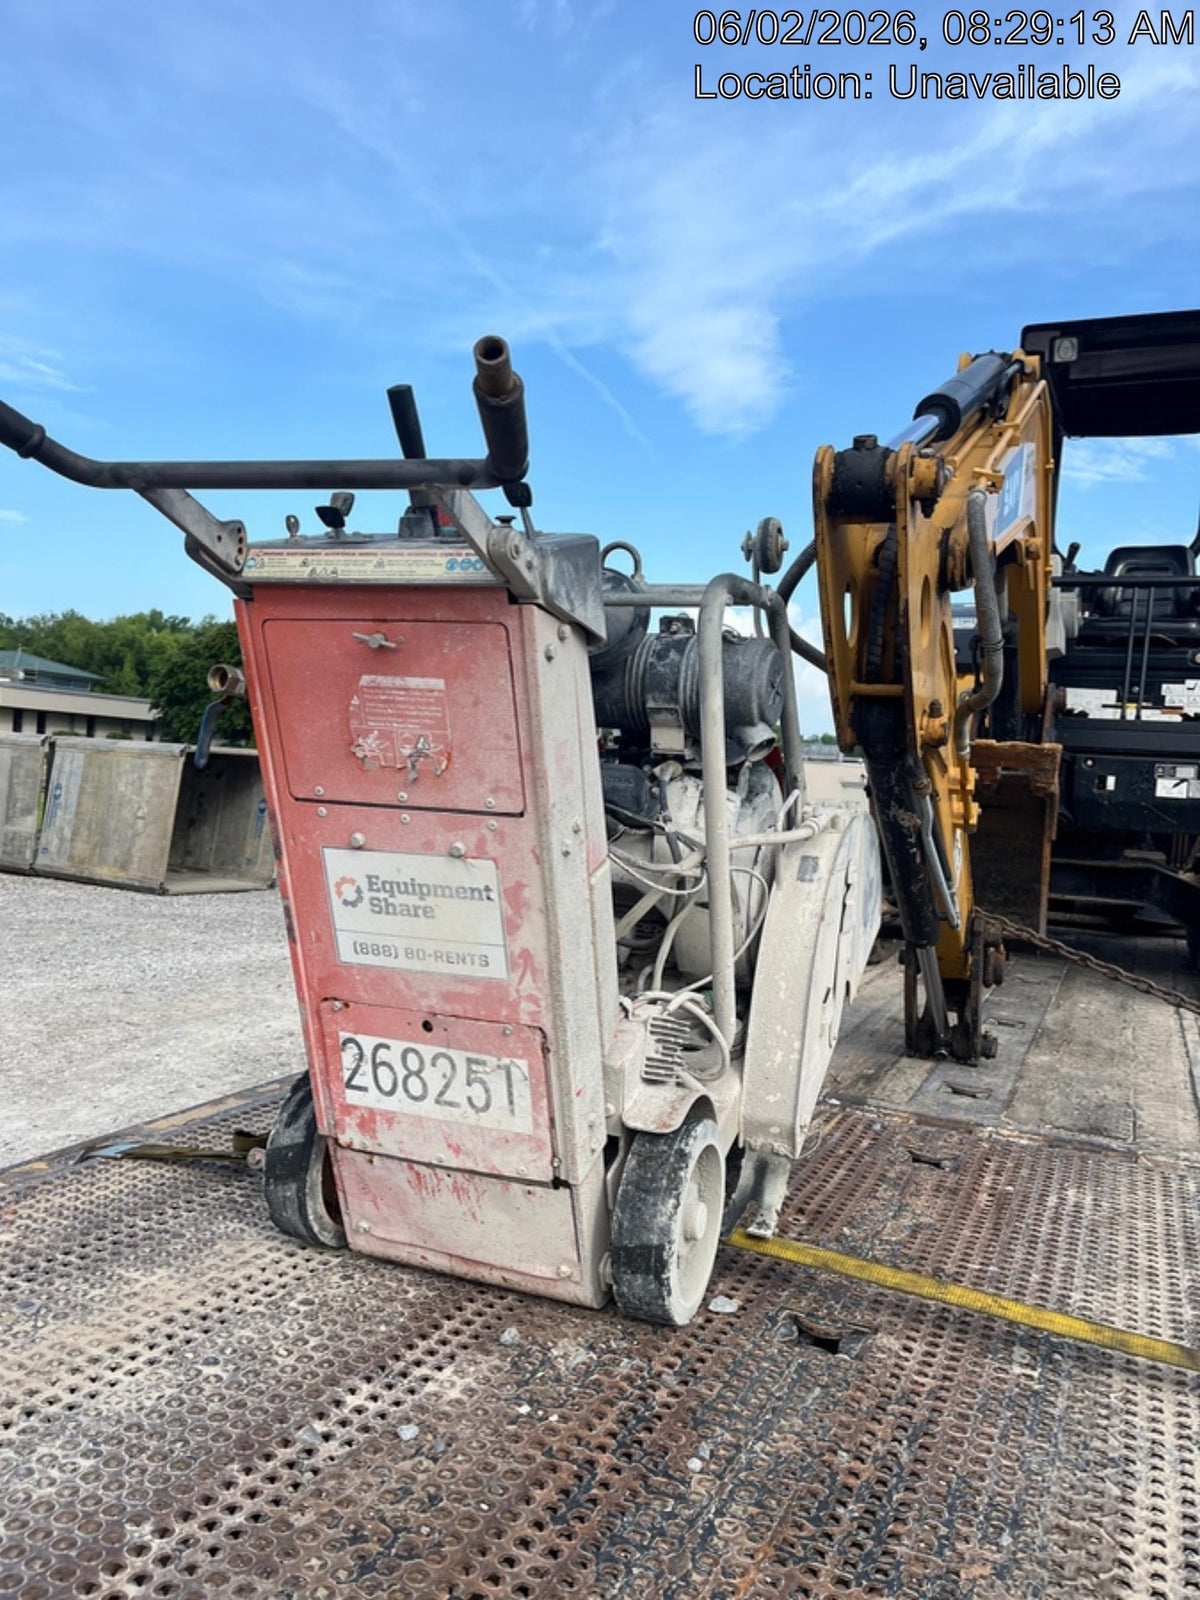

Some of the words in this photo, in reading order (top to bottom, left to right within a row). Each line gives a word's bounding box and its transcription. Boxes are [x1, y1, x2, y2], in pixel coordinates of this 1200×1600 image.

[366, 874, 494, 902] Equipment
[369, 897, 436, 919] Share
[353, 940, 399, 960] (888)
[404, 947, 490, 968] 80-RENTS
[341, 1037, 516, 1117] 268251
